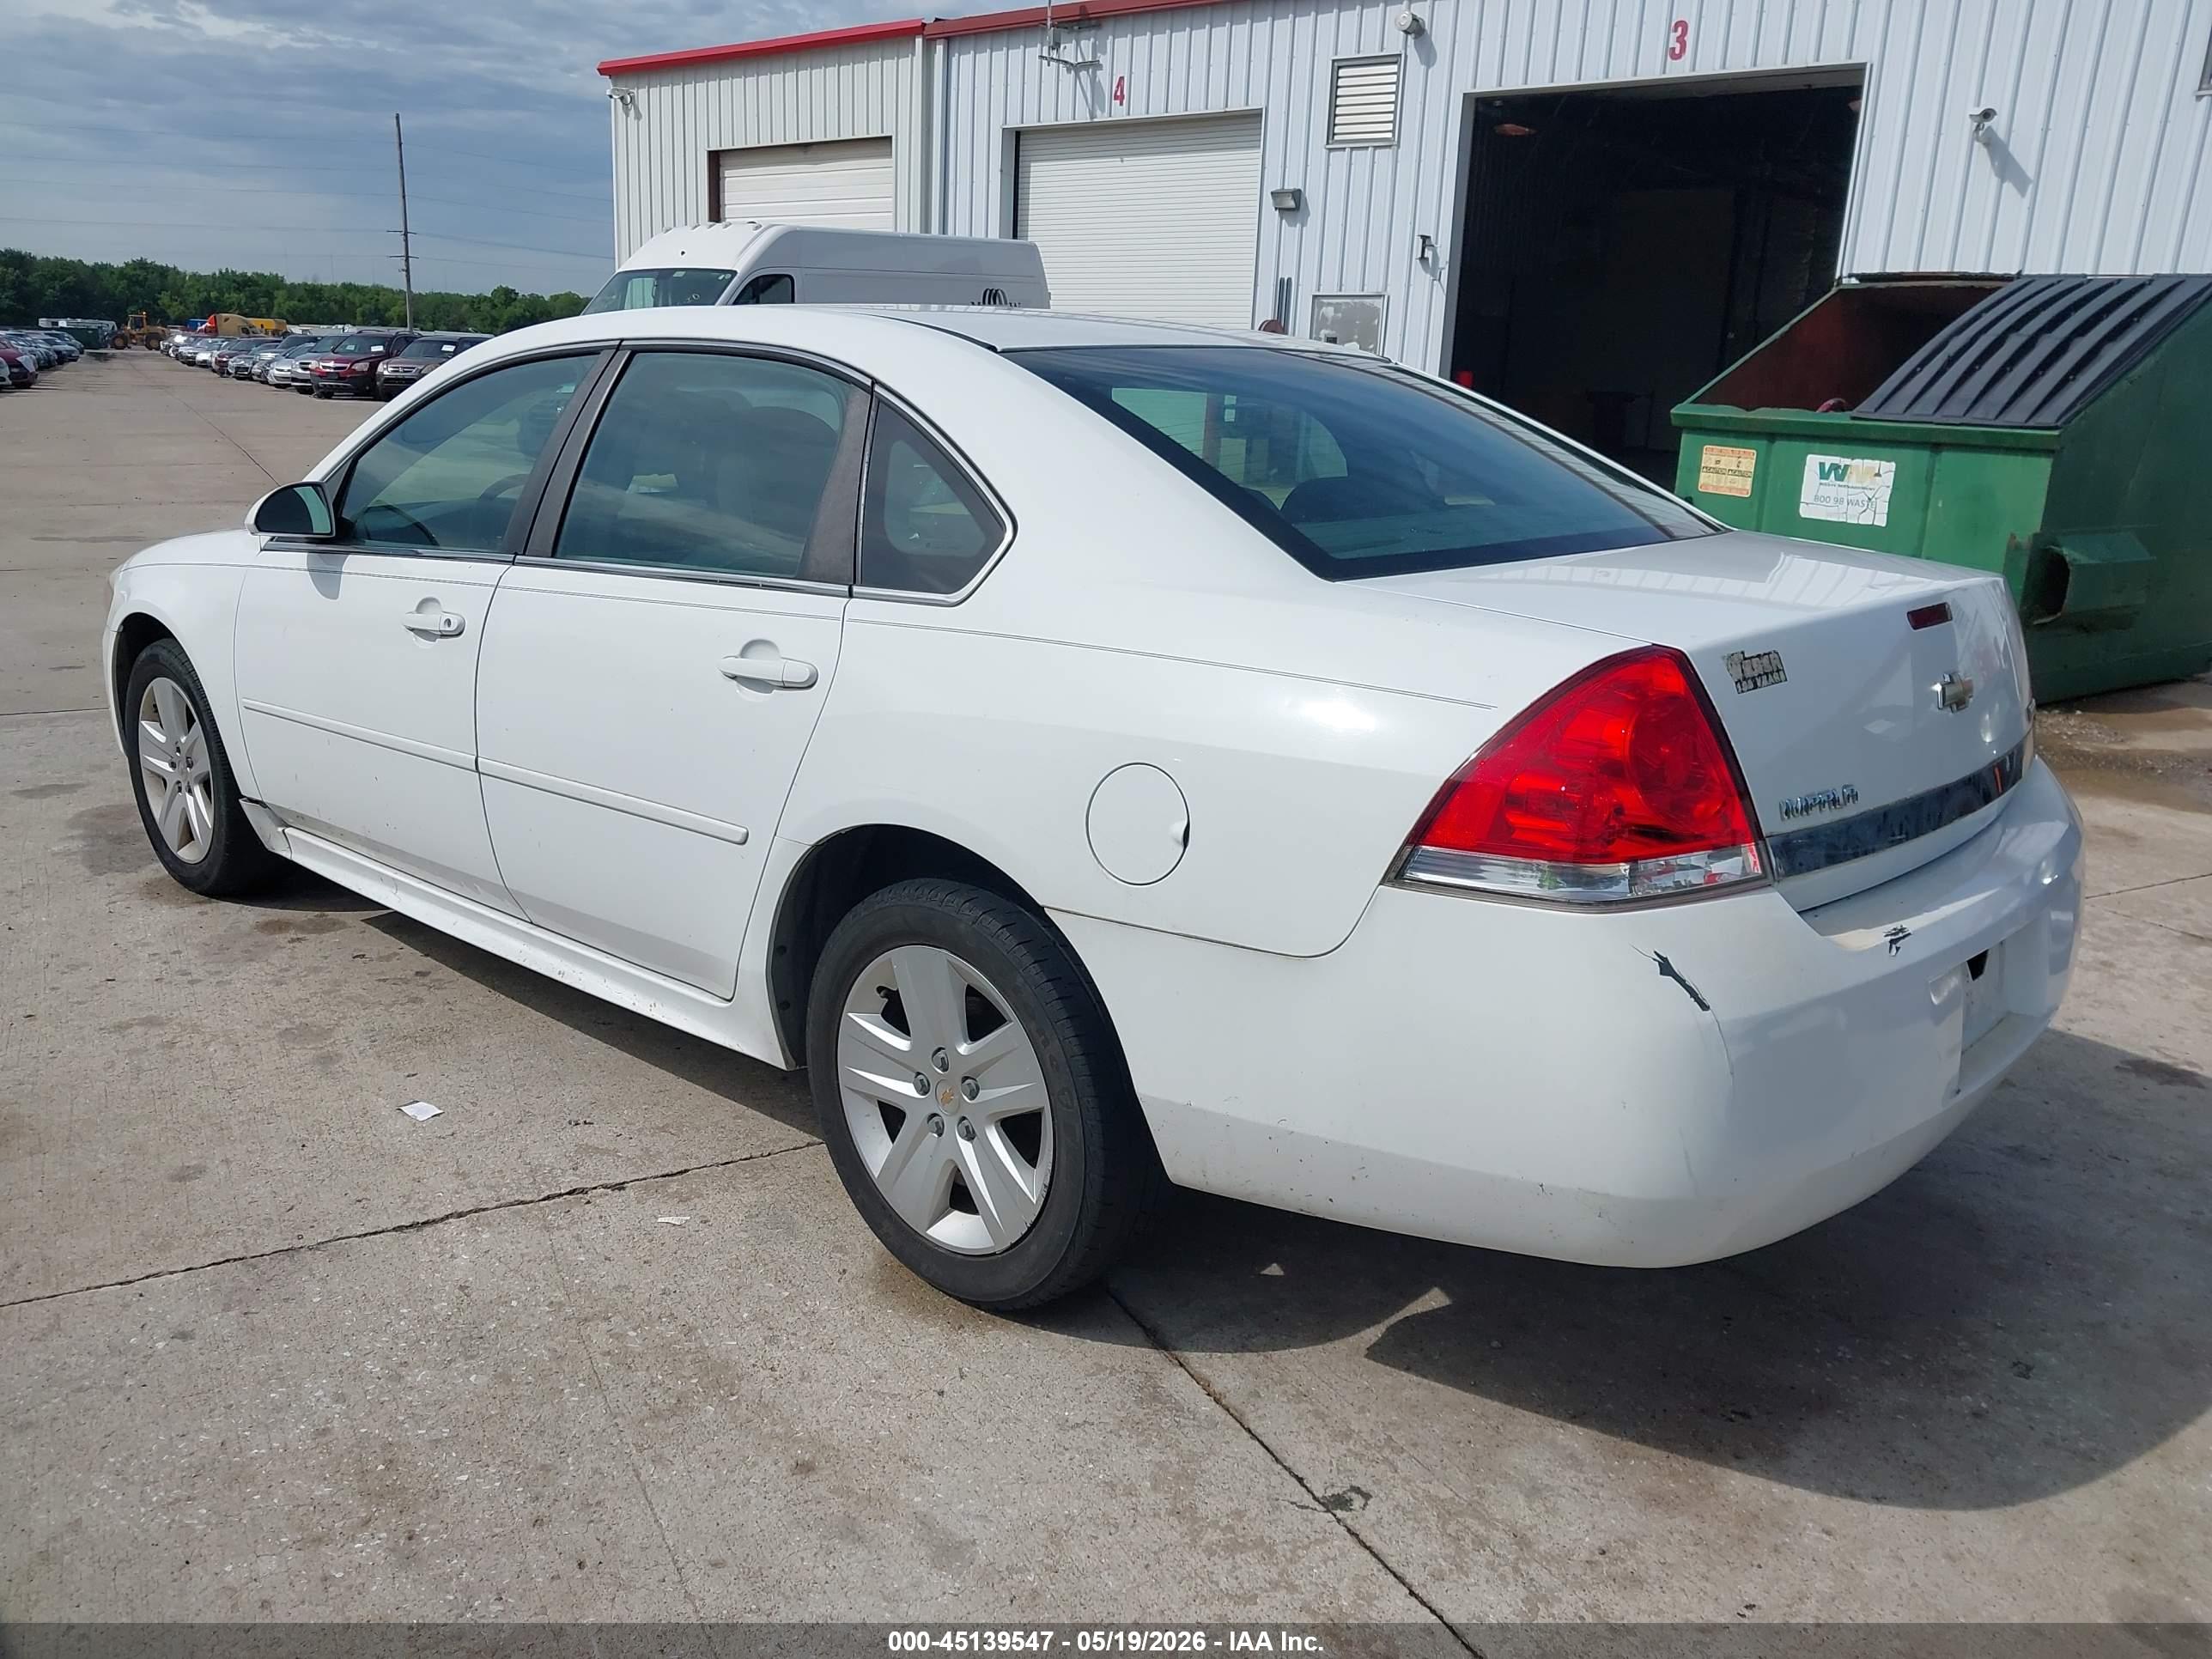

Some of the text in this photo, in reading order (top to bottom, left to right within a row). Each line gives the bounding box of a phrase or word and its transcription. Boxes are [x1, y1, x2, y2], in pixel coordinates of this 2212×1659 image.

[1669, 20, 1689, 61] 3
[1114, 76, 1125, 106] 4
[1814, 494, 1876, 509] 800 98 WASTE
